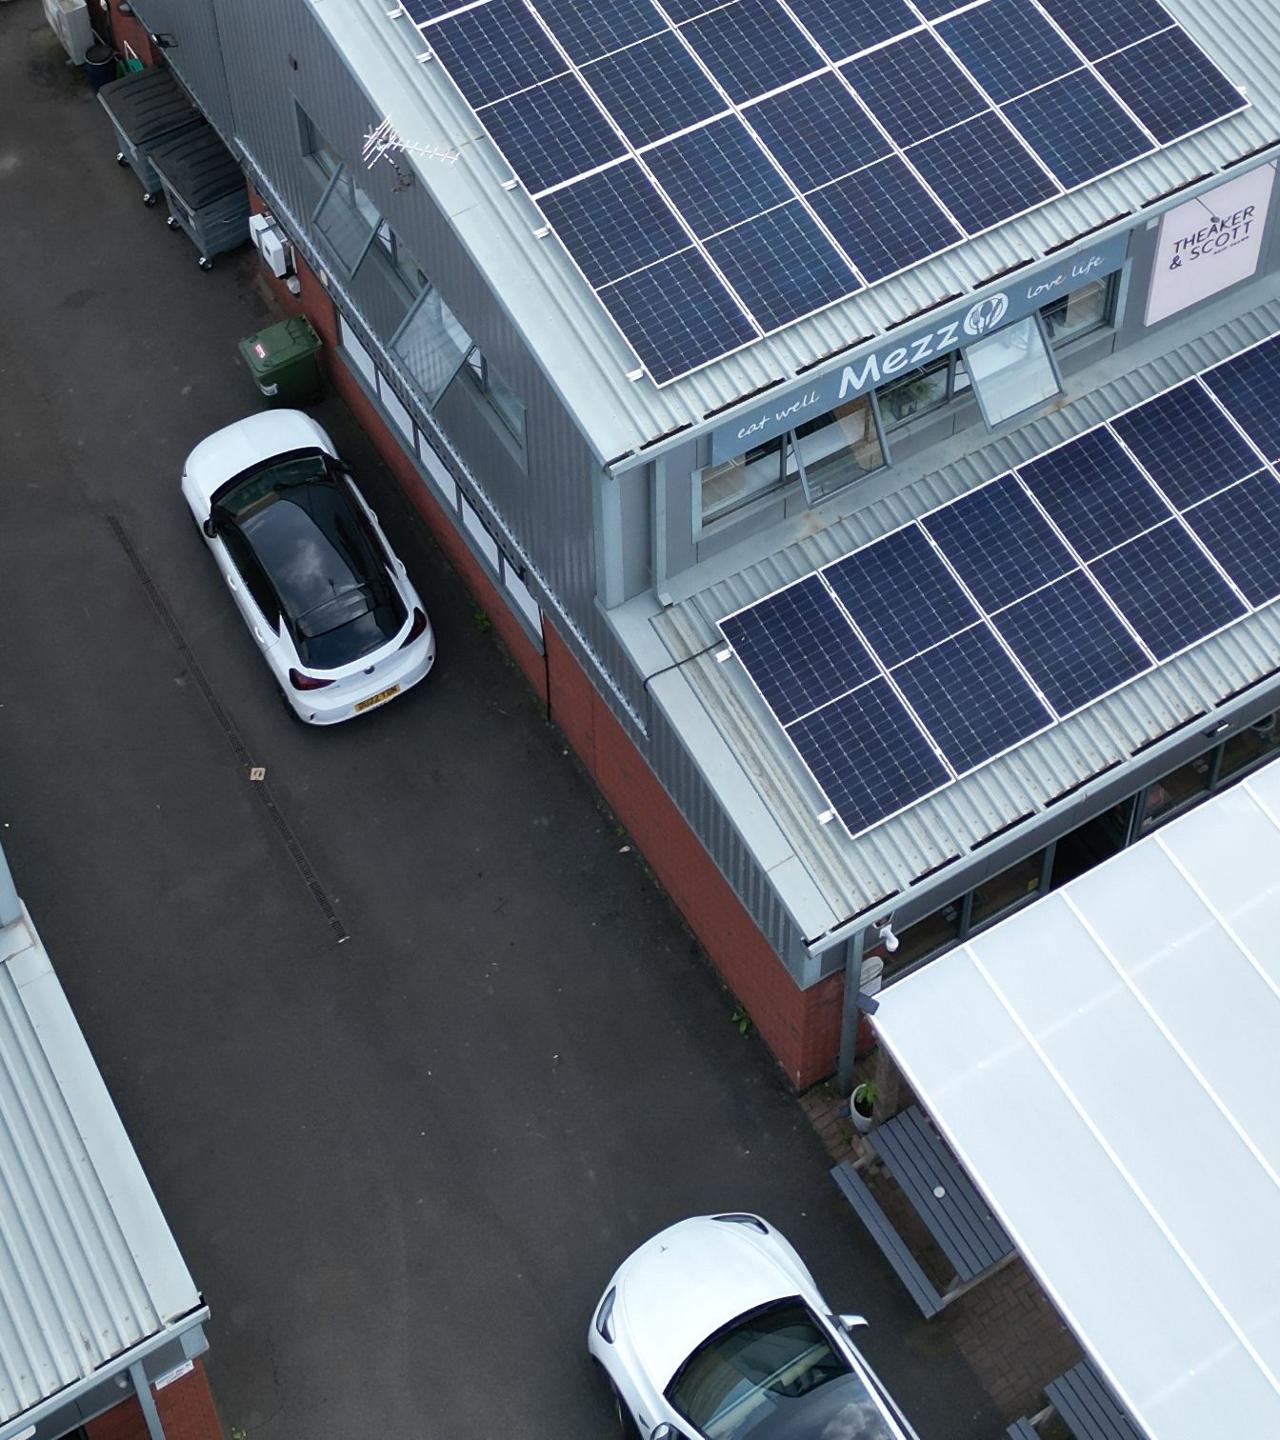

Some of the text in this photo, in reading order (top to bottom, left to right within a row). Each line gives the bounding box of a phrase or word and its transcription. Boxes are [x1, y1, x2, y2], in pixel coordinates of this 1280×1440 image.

[1169, 255, 1182, 270] &
[1189, 220, 1254, 261] SCOTT
[1173, 205, 1256, 254] THEAKER
[737, 415, 770, 439] eat
[775, 391, 820, 421] well
[1027, 274, 1066, 299] love
[1072, 255, 1105, 278] life
